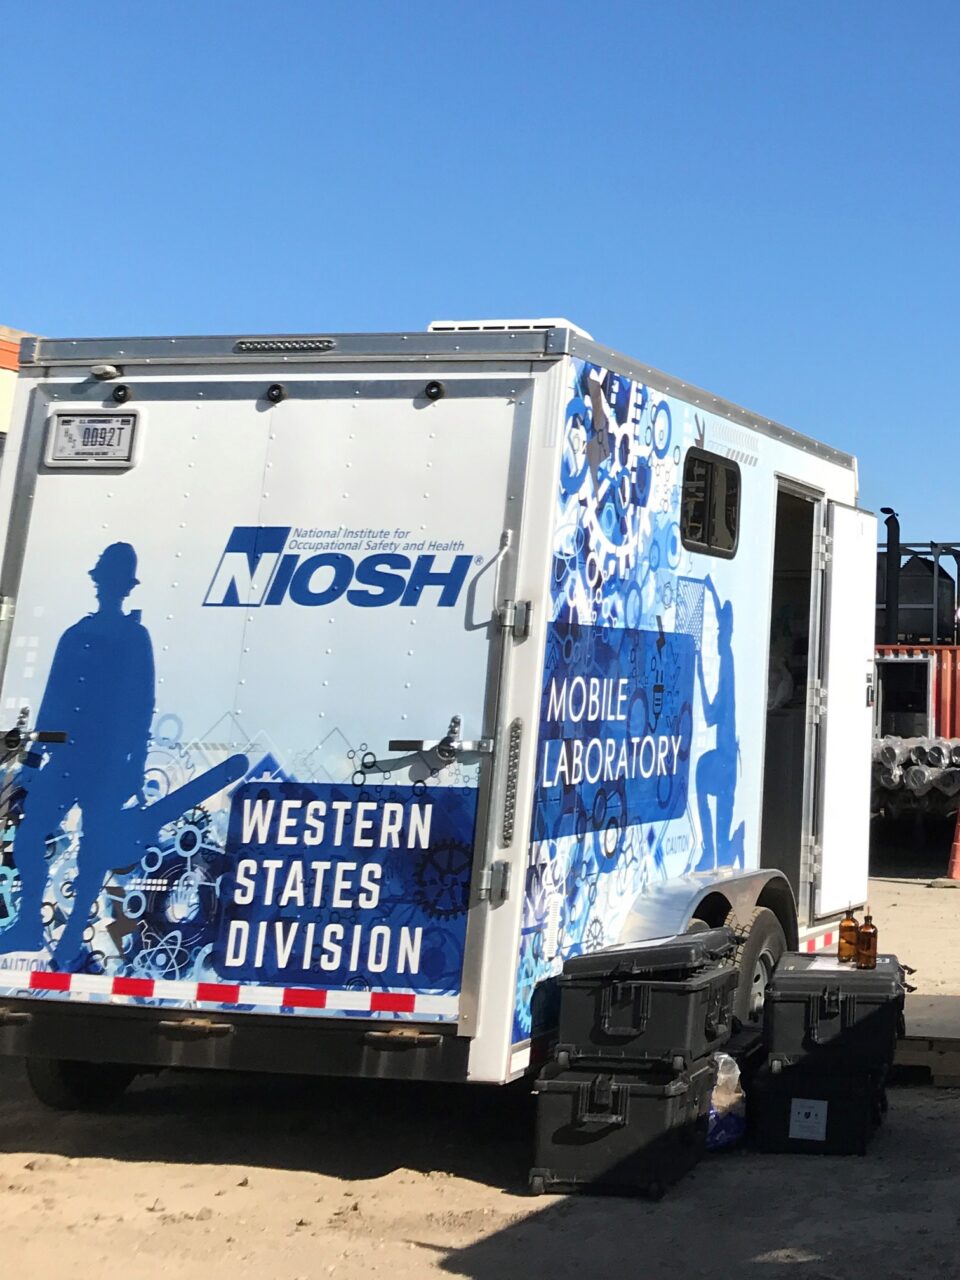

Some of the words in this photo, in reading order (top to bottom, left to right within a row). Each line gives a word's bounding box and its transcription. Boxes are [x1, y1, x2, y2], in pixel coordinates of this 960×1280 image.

[82, 427, 125, 447] 0092T
[288, 540, 362, 553] Occupational
[364, 540, 402, 553] Safety
[403, 540, 426, 551] and
[427, 540, 465, 552] Health
[292, 528, 339, 538] National
[343, 528, 391, 539] Institute
[392, 528, 410, 539] for
[202, 551, 474, 608] NIOSH
[547, 676, 628, 723] MOBILE
[542, 735, 683, 788] LABORATORY
[242, 799, 433, 850] WESTERN
[234, 859, 383, 910] STATES
[225, 920, 423, 975] DIVISION
